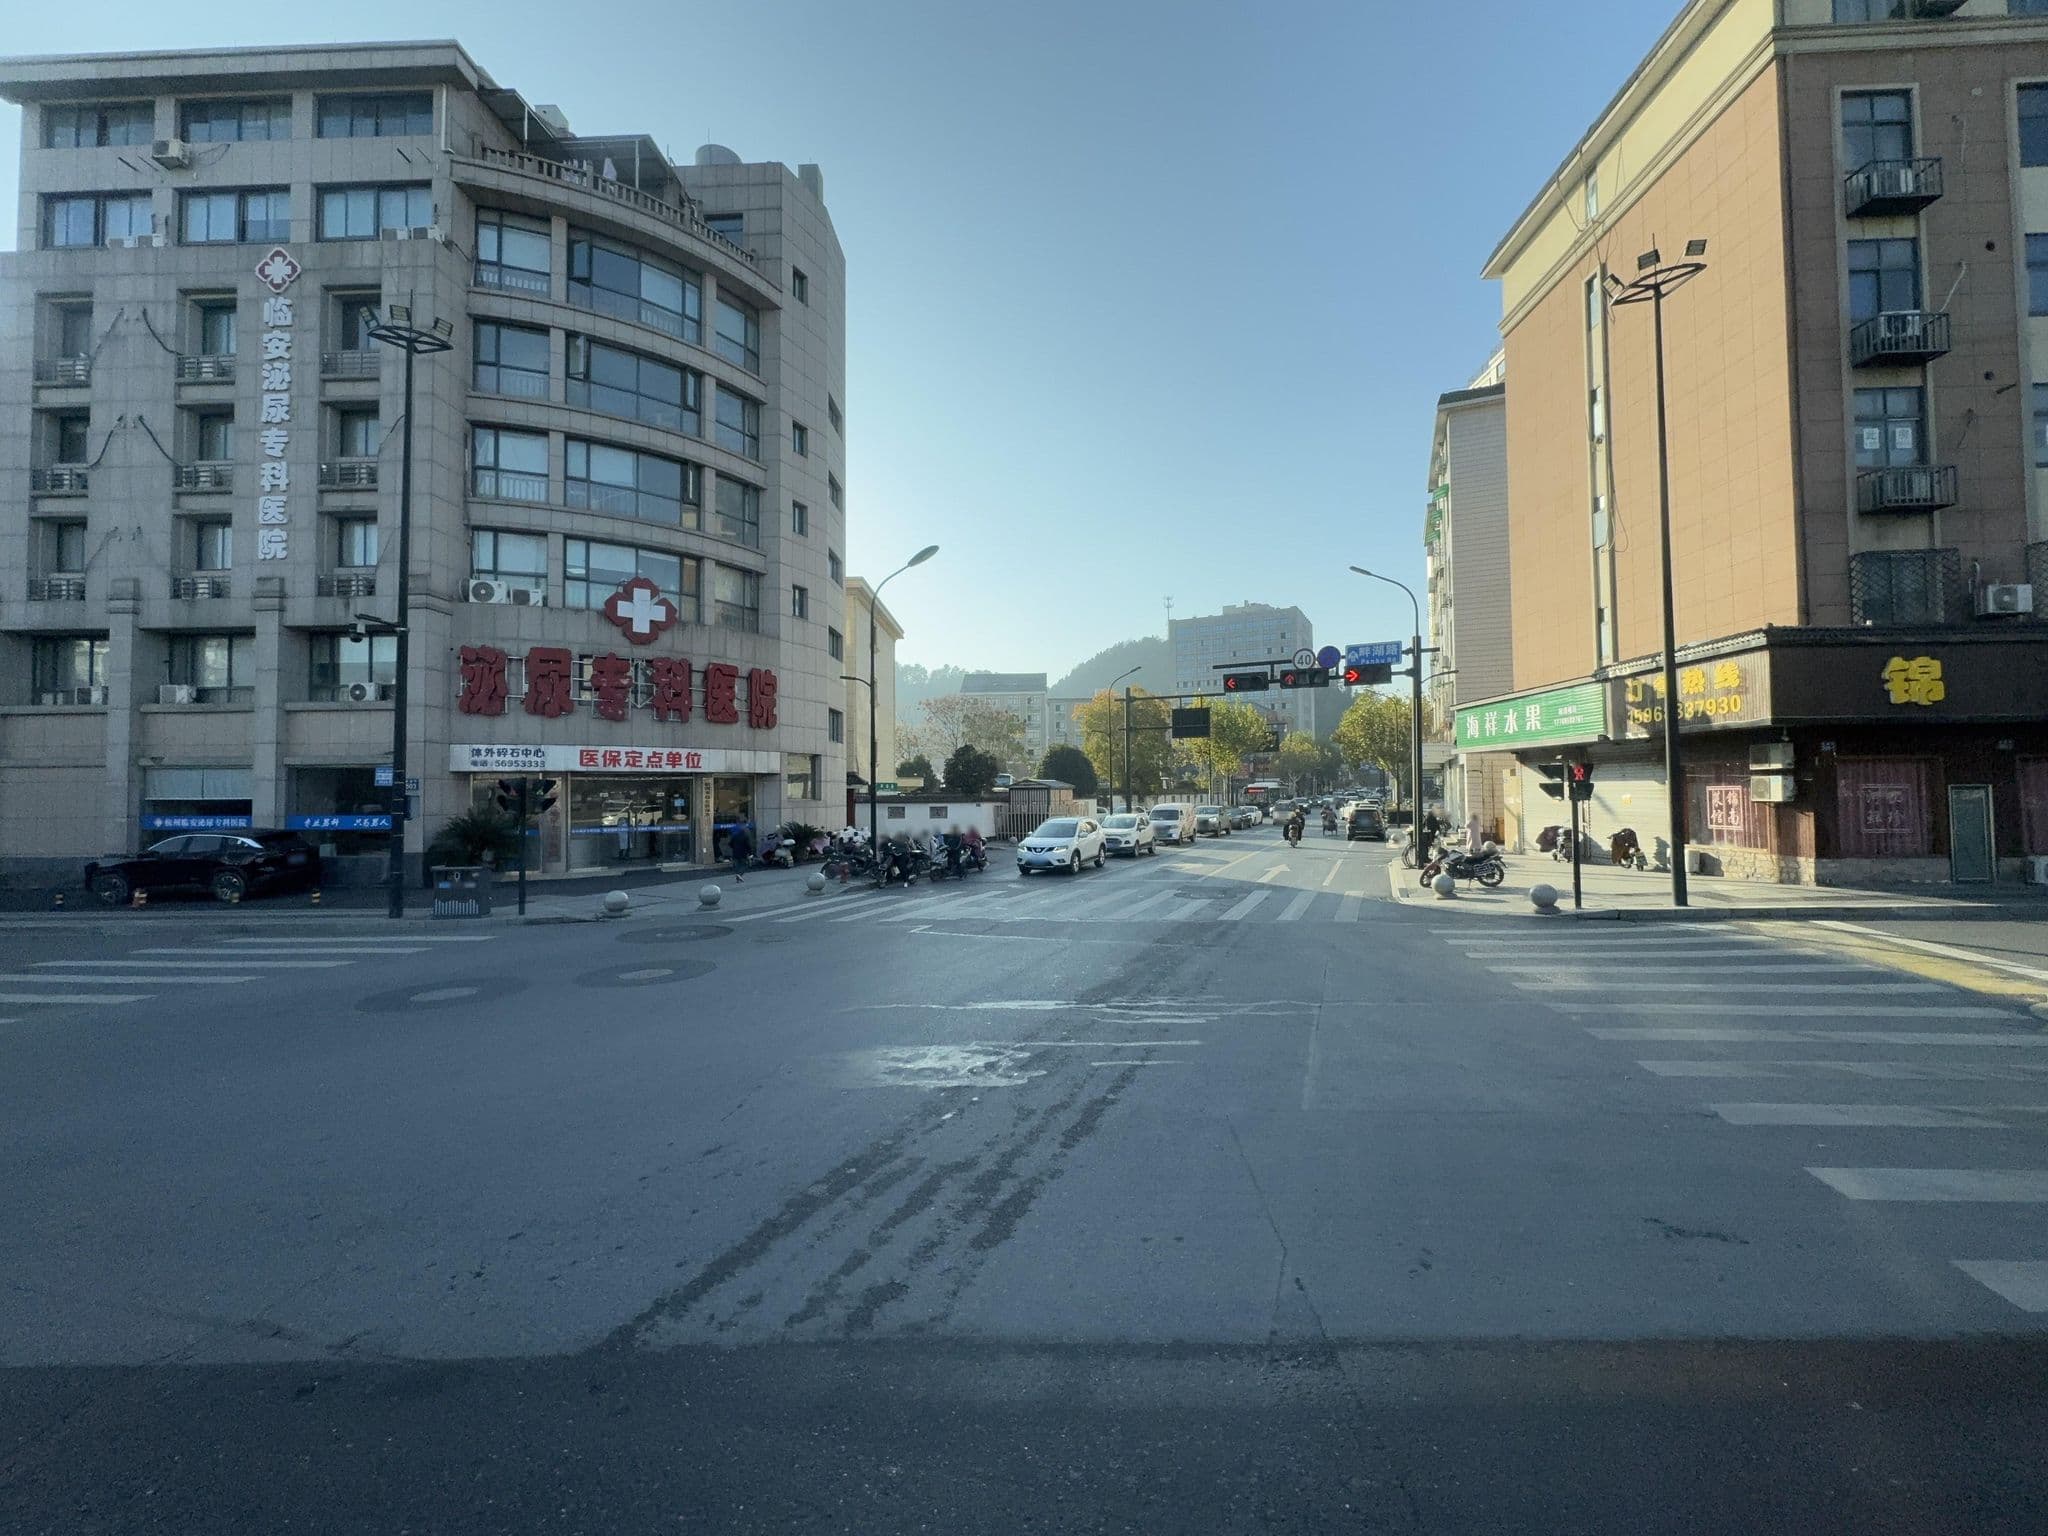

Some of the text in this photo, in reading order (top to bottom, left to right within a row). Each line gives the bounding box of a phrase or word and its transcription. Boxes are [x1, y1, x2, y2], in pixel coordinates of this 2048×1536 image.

[258, 296, 292, 559] 临安泌尿专科医院
[1297, 654, 1311, 666] 40
[458, 645, 777, 729] 泌尿专科医院
[1466, 703, 1542, 739] 海祥水果
[471, 747, 545, 758] 体外碎石中心
[579, 749, 702, 769] 医保定点单位
